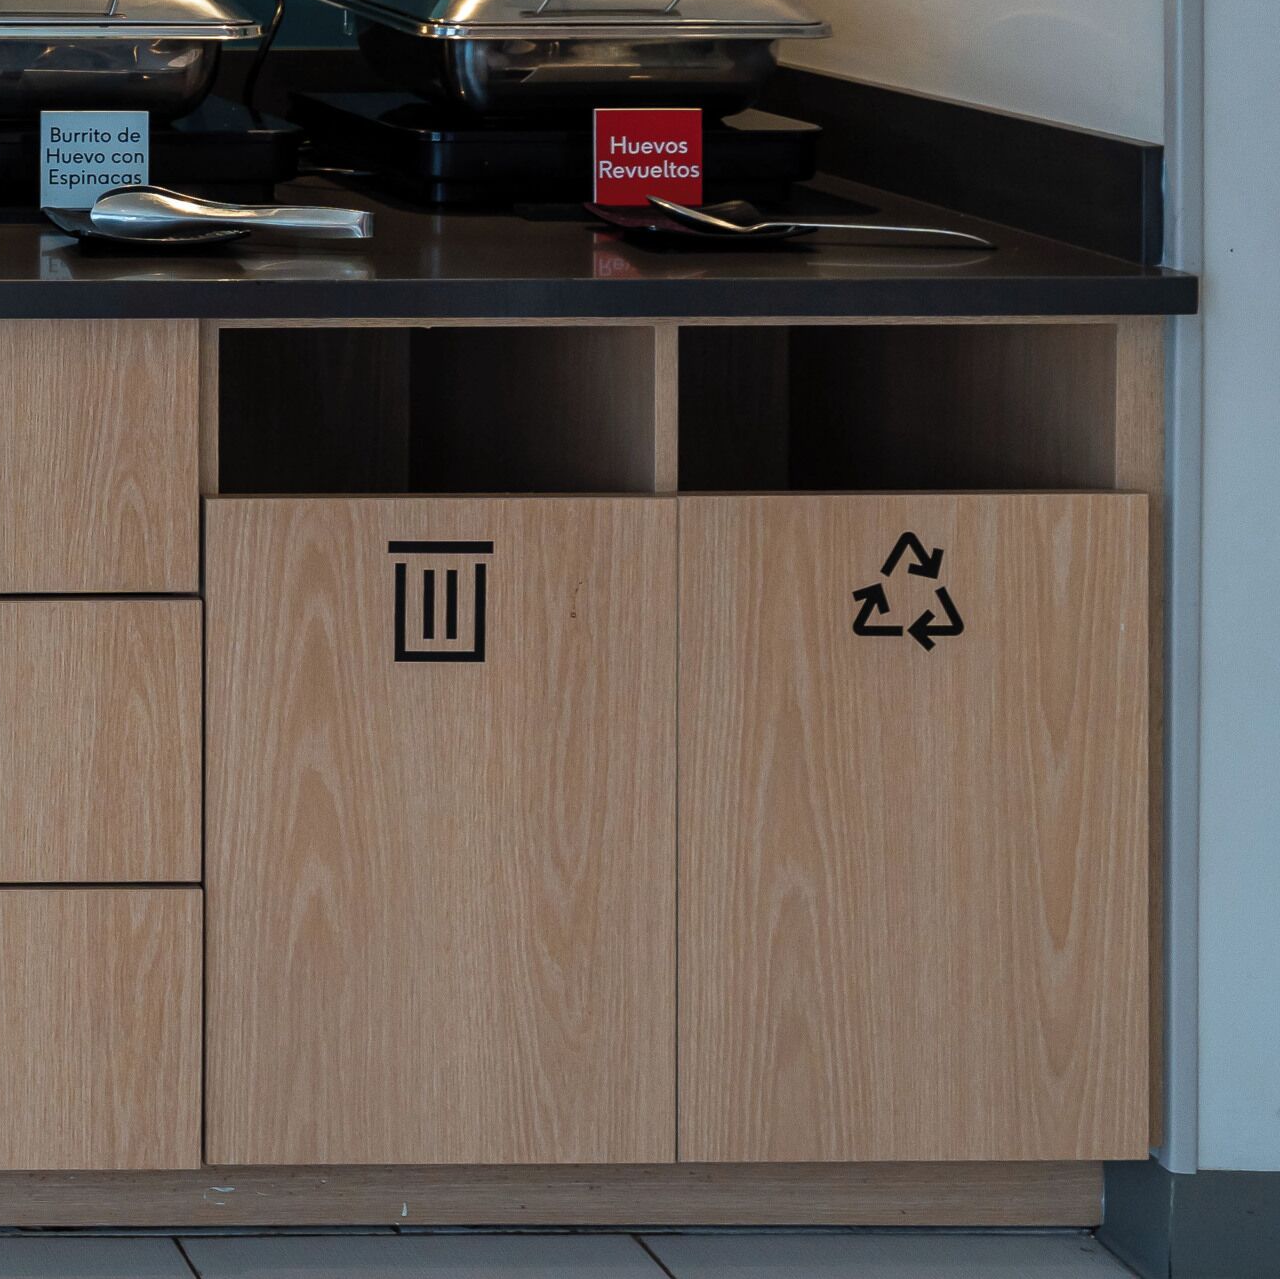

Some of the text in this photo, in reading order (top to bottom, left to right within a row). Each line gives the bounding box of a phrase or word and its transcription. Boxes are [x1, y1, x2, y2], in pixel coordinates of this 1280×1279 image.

[50, 127, 141, 143] Burrito de
[610, 136, 688, 154] Huevos
[46, 148, 144, 164] Huevo con
[599, 160, 700, 179] Revueltos
[49, 169, 142, 189] Espinacas
